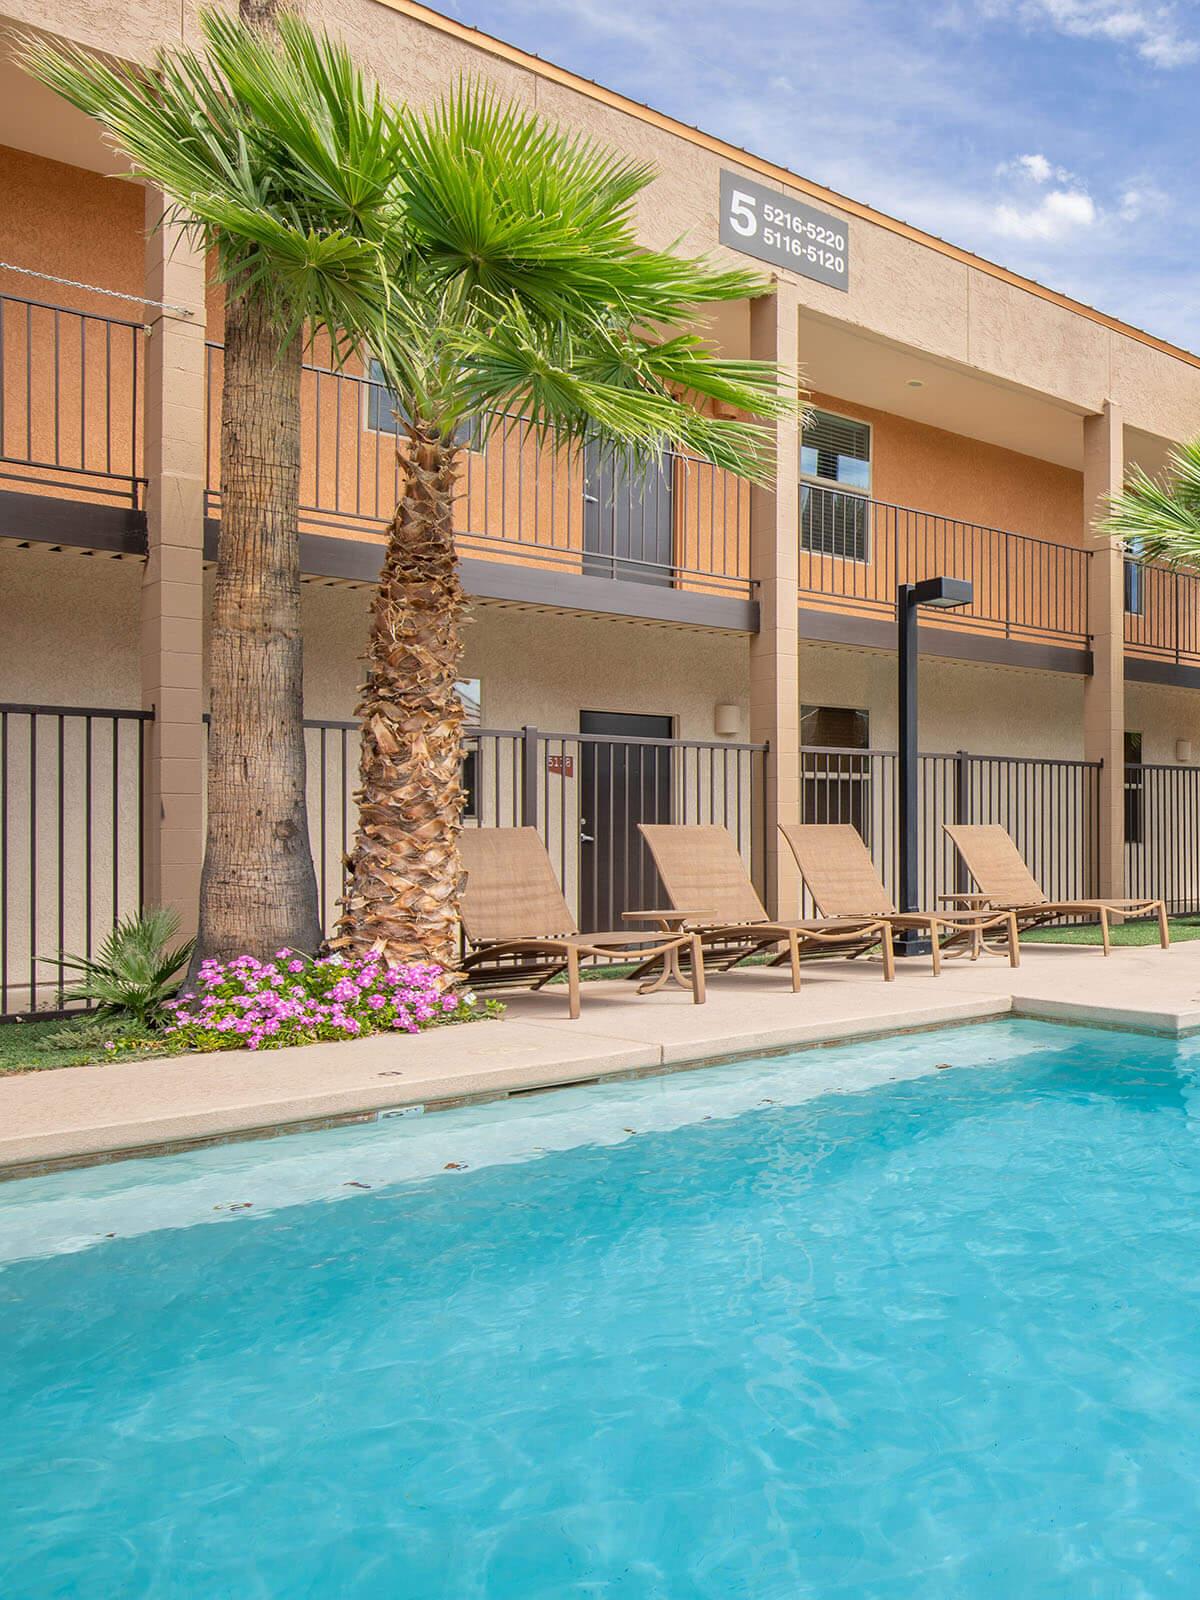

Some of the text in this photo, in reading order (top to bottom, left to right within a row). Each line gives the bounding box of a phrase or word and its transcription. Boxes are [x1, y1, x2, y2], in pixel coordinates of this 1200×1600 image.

[729, 190, 757, 237] 5
[763, 204, 845, 251] 5216-5220
[763, 227, 845, 273] 5116-5120
